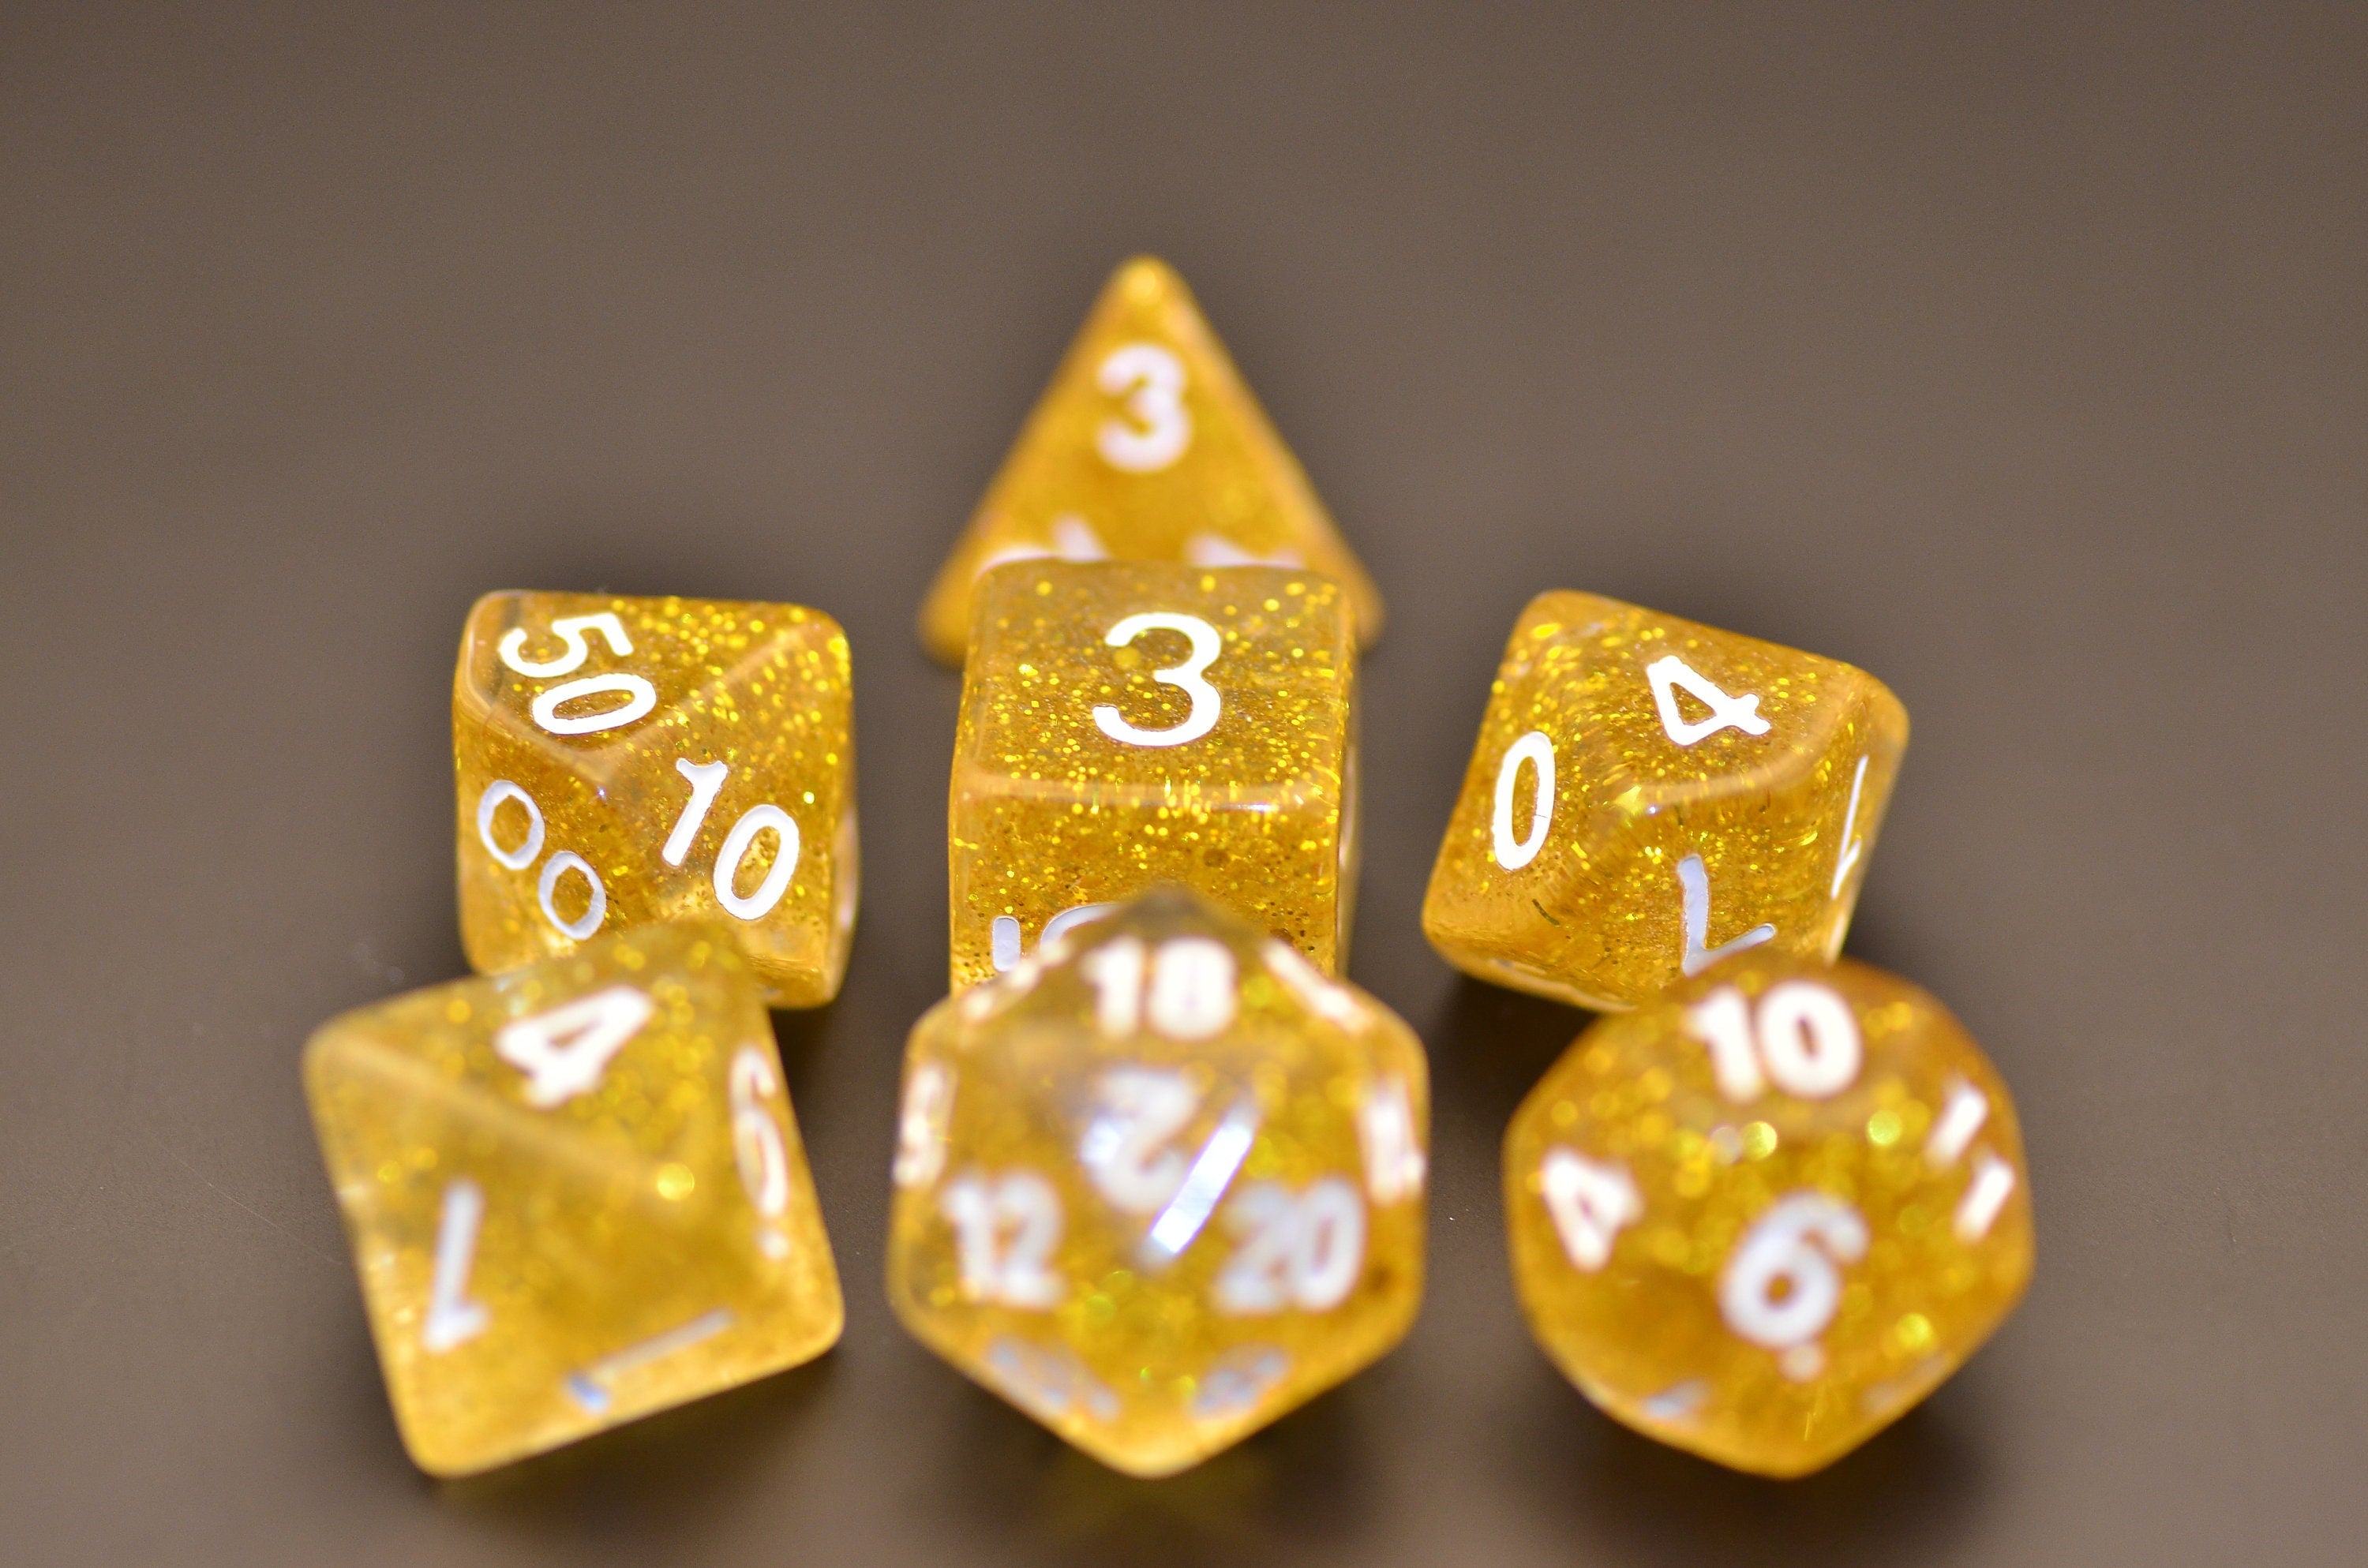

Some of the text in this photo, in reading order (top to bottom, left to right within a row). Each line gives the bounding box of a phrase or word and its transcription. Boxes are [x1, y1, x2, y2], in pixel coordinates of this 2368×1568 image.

[1098, 343, 1190, 472] 3
[499, 613, 657, 734] 50
[1093, 612, 1221, 746] 3
[1647, 655, 1770, 746] 4
[478, 780, 606, 940] 00
[662, 758, 800, 920] 10
[1493, 731, 1557, 871] 0
[496, 986, 654, 1109] 4
[1688, 979, 1864, 1103] 10
[942, 1172, 1067, 1310] 12
[1216, 1176, 1366, 1314] 20
